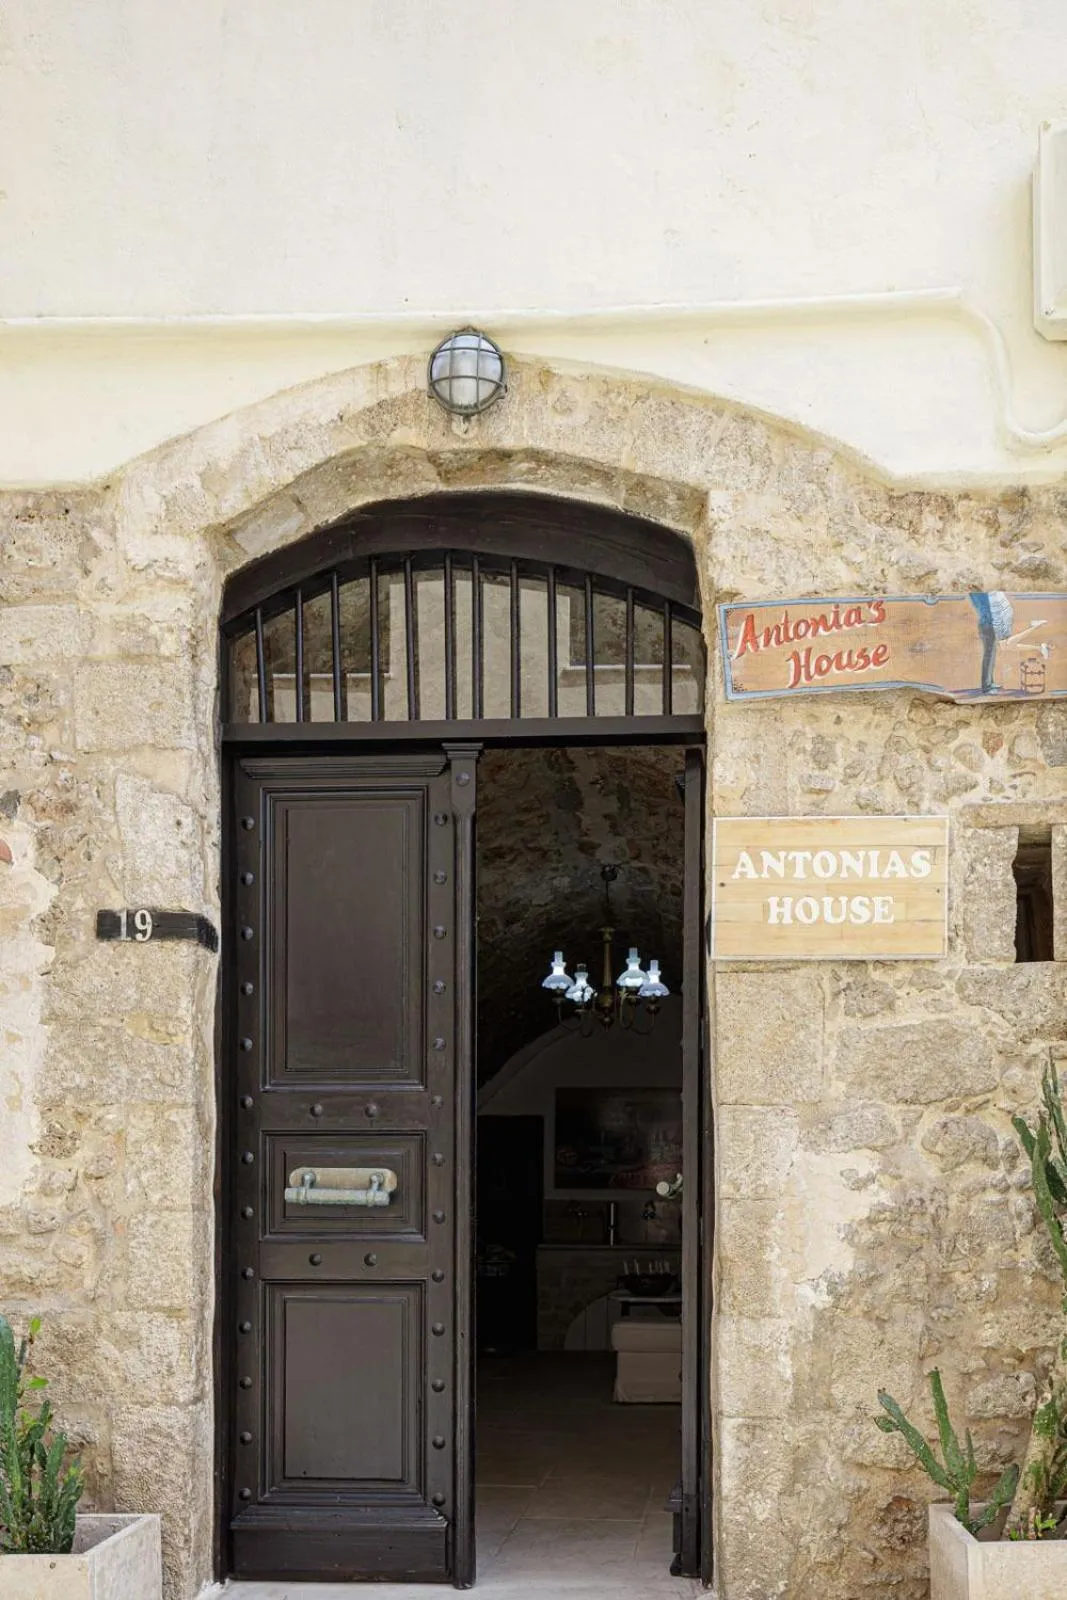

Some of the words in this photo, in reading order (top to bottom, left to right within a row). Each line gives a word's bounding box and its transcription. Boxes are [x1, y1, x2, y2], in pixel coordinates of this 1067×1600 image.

[733, 600, 886, 659] Antonia's
[787, 644, 889, 689] House
[732, 850, 931, 879] ANTONIAS
[116, 909, 152, 941] 19
[767, 896, 895, 924] HOUSE
